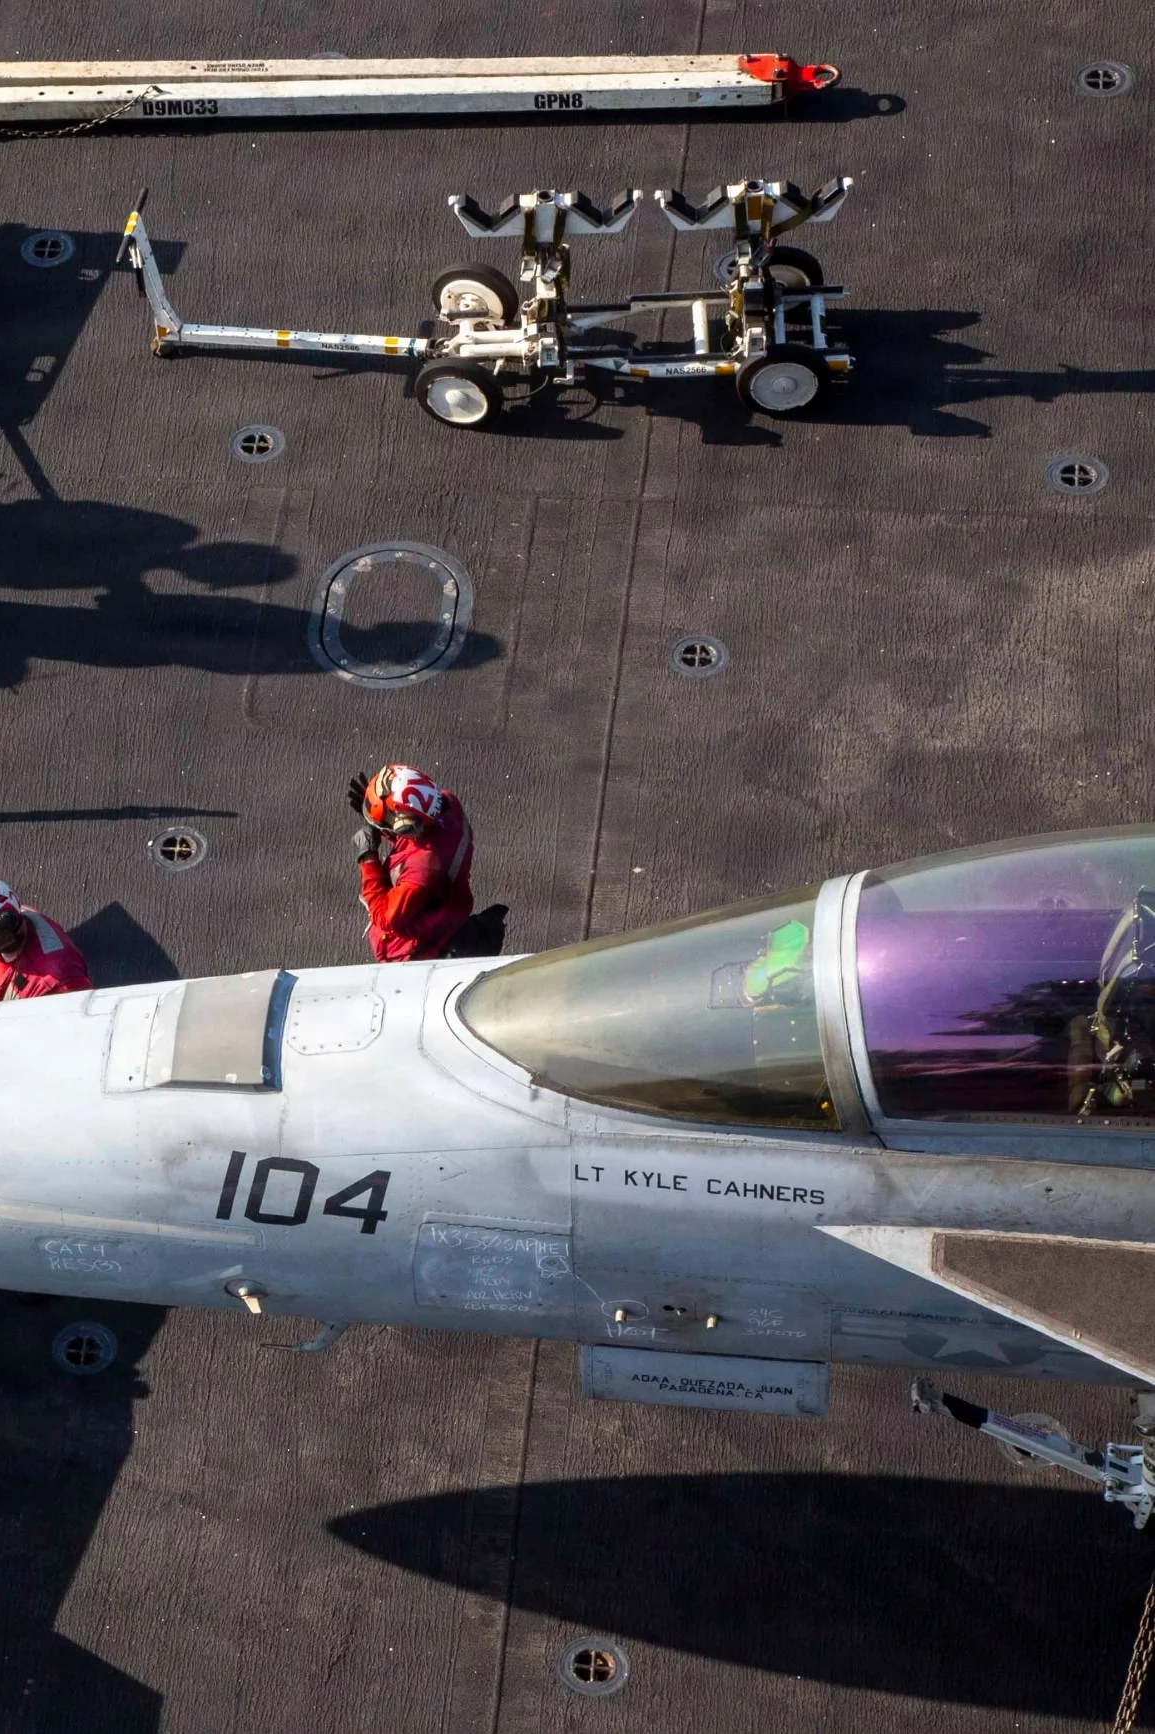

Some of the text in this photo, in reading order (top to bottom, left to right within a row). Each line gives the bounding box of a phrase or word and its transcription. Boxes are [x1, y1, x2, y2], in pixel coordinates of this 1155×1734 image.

[534, 93, 583, 109] GPN8
[216, 1150, 391, 1234] 104
[574, 1164, 825, 1206] LT KYLE CAHNERS
[45, 1240, 89, 1254] CAT
[744, 1391, 764, 1400] CA
[756, 1385, 793, 1396] JUAN
